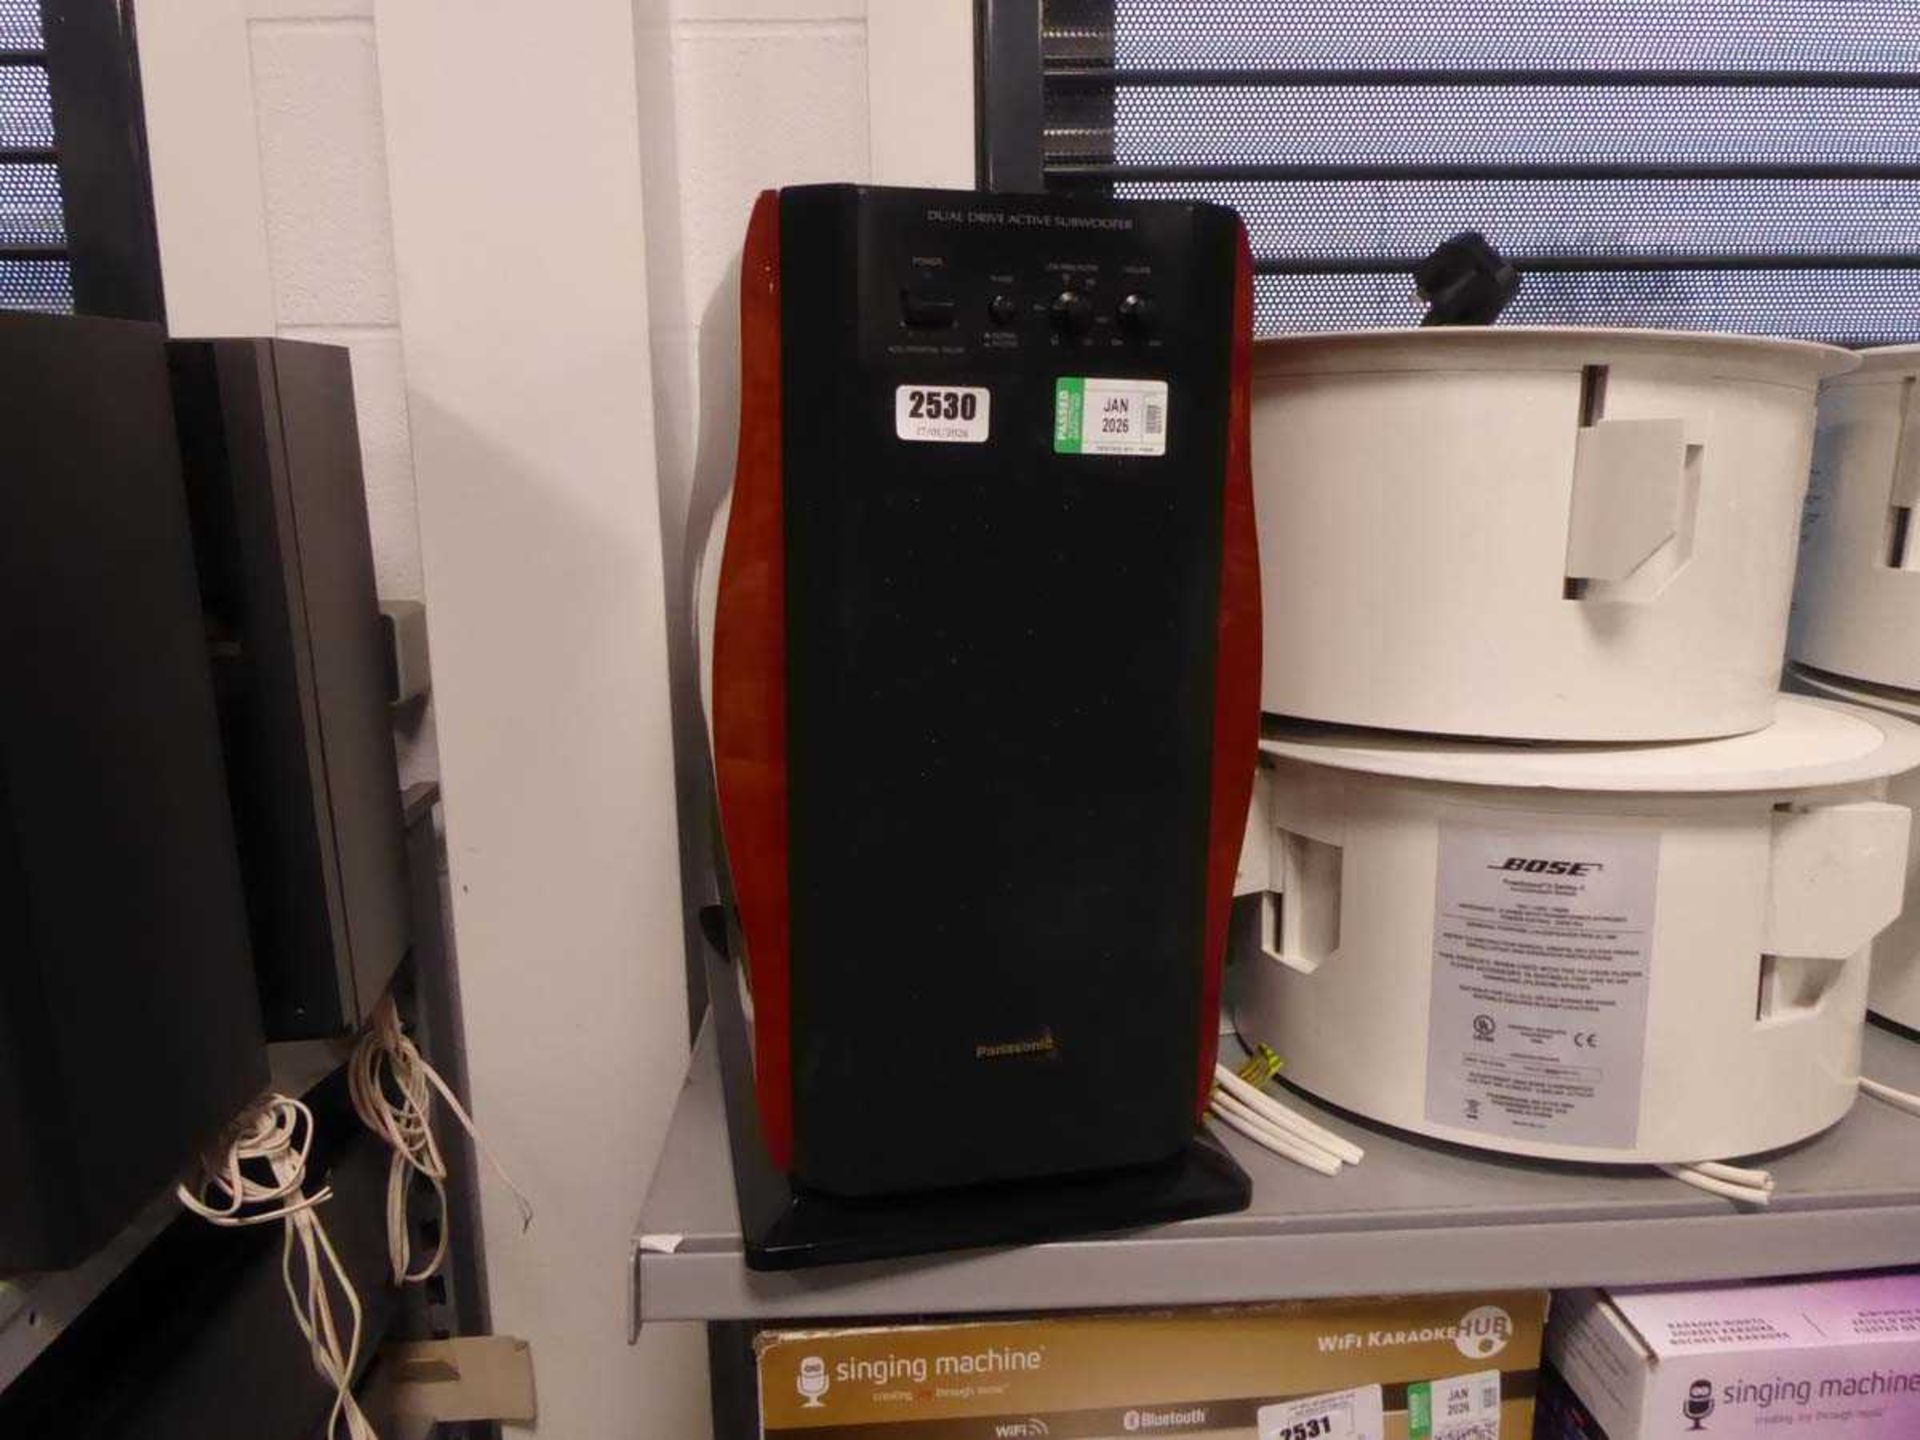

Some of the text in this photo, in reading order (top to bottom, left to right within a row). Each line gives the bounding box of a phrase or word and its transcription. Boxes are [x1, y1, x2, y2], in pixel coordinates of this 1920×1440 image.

[927, 210, 1133, 230] DUAL DRIVE ACTIVE SUBWOOFER
[908, 390, 977, 422] 2530
[1103, 398, 1129, 414] JAN
[1102, 417, 1129, 434] 2026
[1502, 857, 1590, 878] BOSE
[1368, 1325, 1461, 1347] KARAOKE
[836, 1347, 1042, 1385] singing machine
[1449, 1388, 1469, 1401] JAN
[1723, 1370, 1920, 1408] singing machine
[1141, 1409, 1205, 1427] Bluetooth
[1280, 1415, 1331, 1440] 2531
